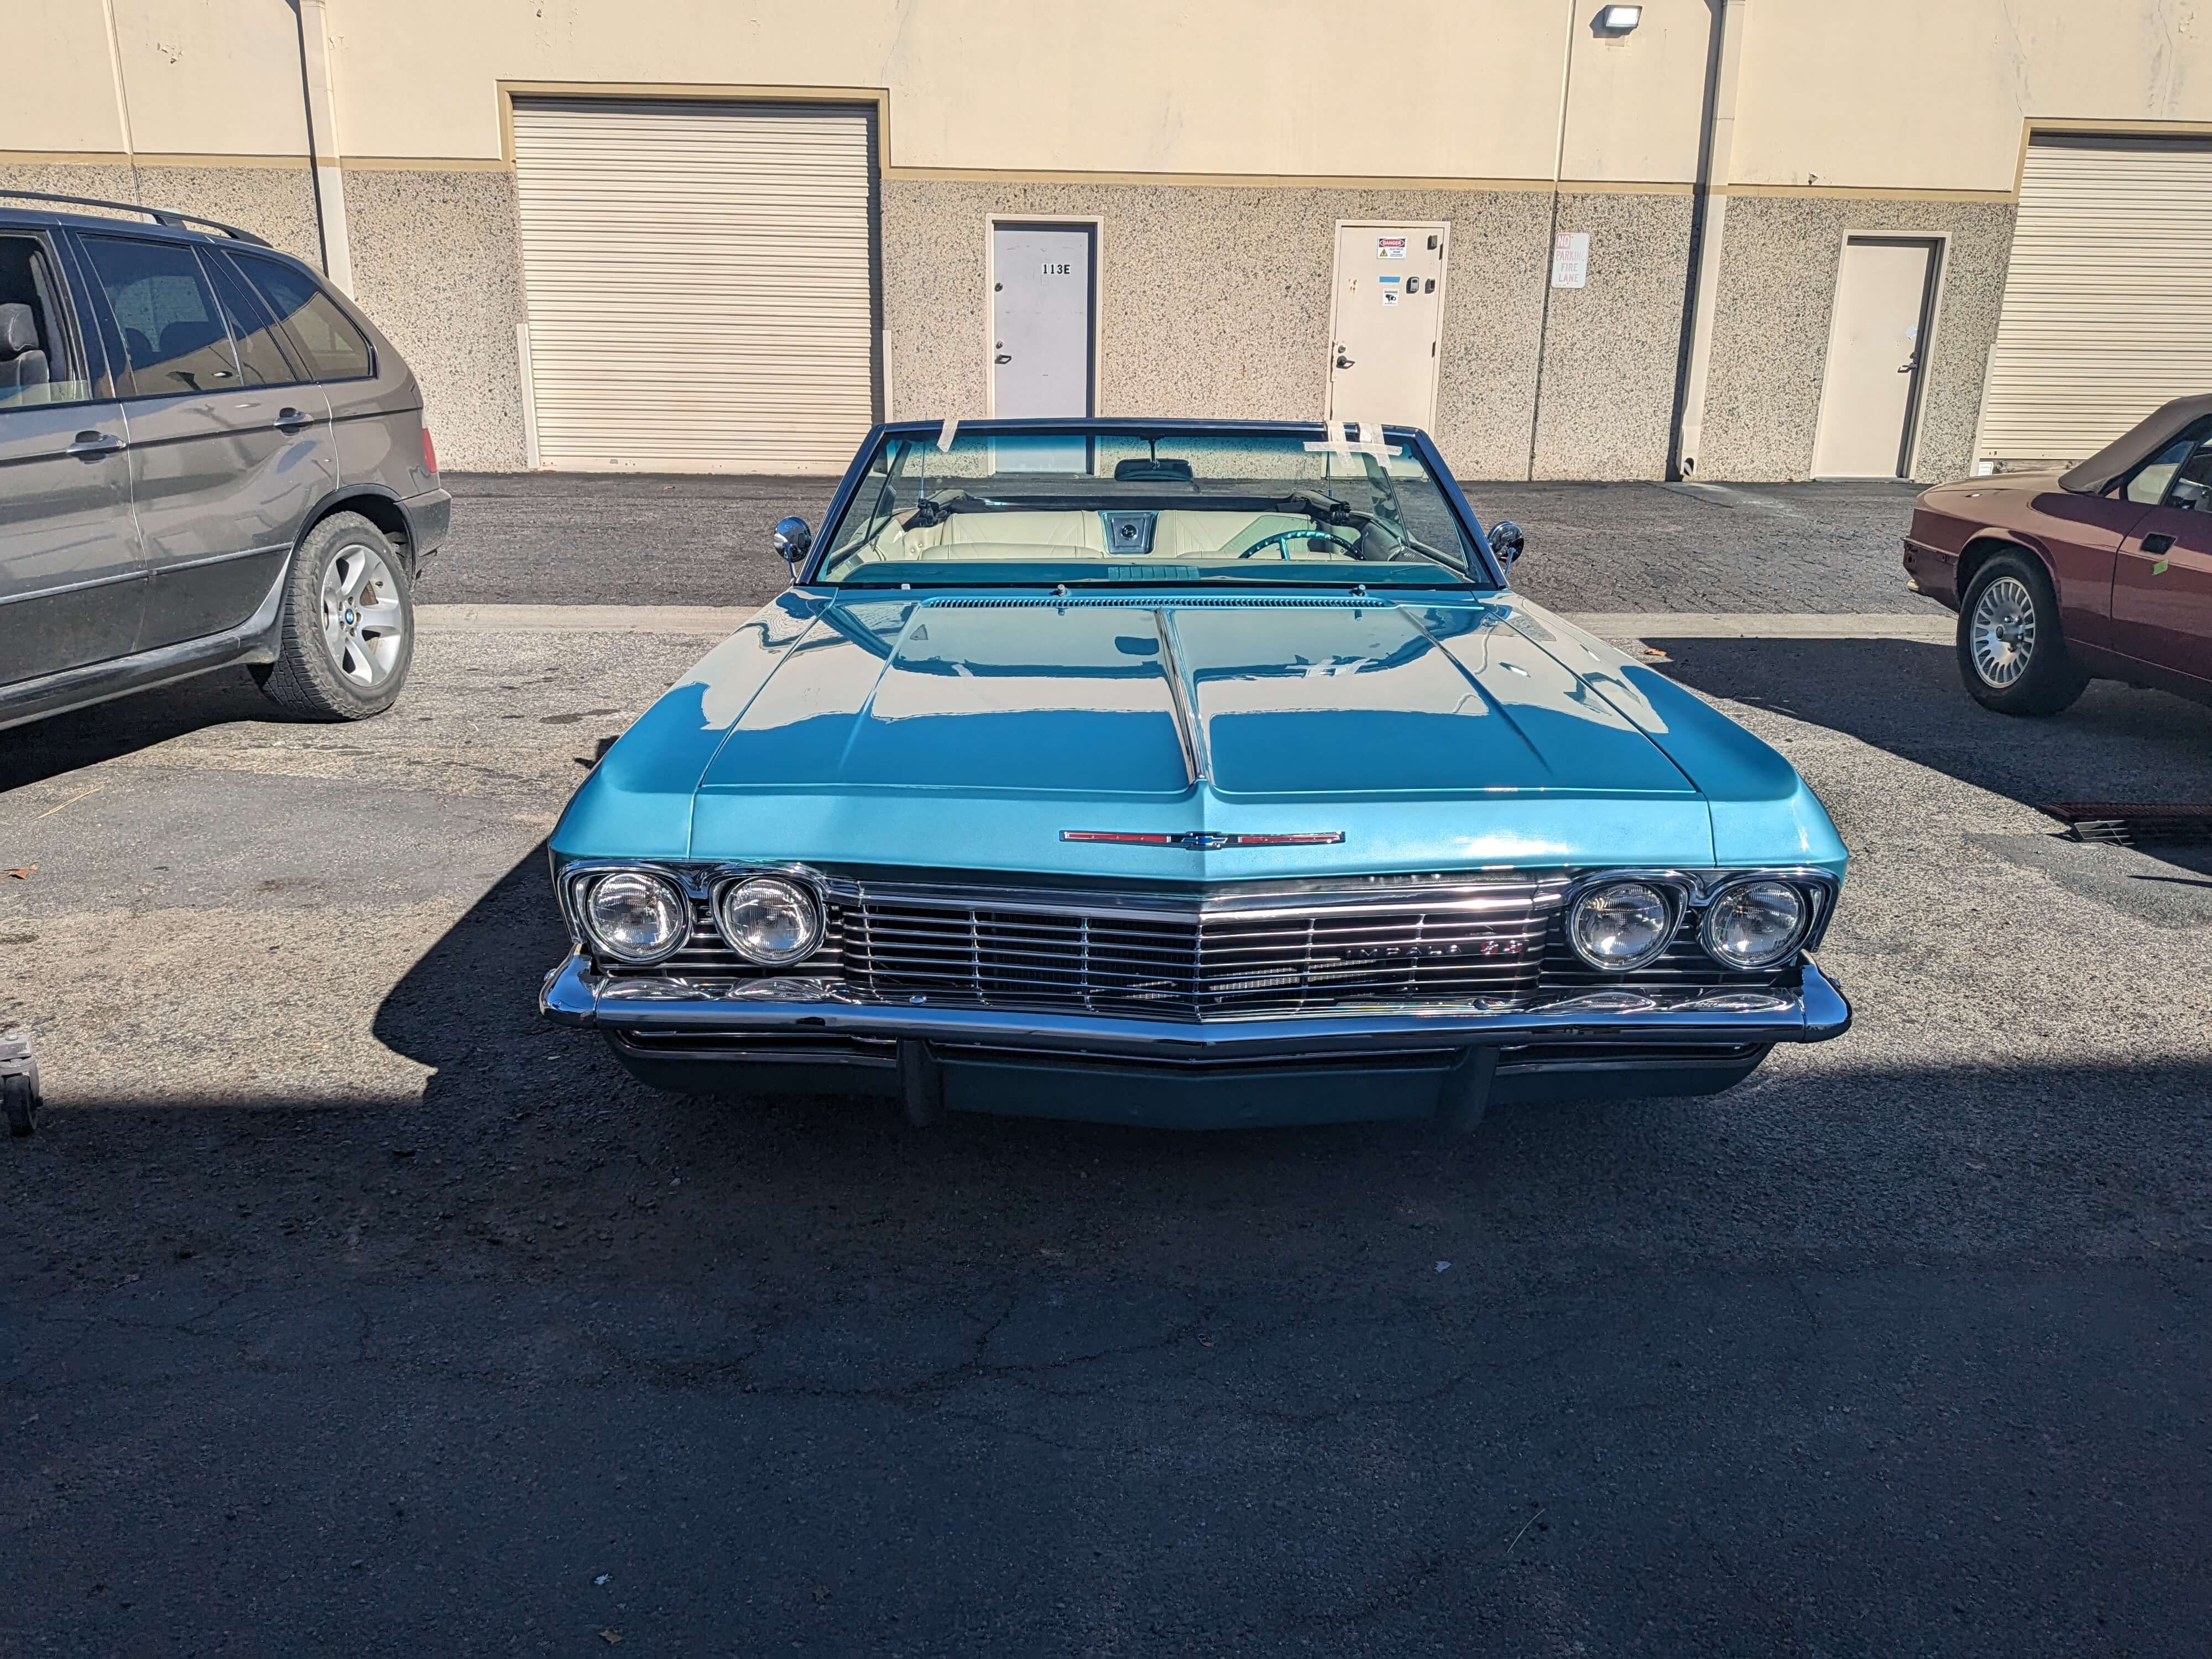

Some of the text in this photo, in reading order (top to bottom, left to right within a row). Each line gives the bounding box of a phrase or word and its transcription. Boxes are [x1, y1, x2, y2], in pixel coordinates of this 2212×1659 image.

[1558, 235, 1569, 247] NO
[1043, 264, 1071, 274] 113E
[1561, 263, 1578, 272] FIRE
[1346, 945, 1462, 958] IMPALA
